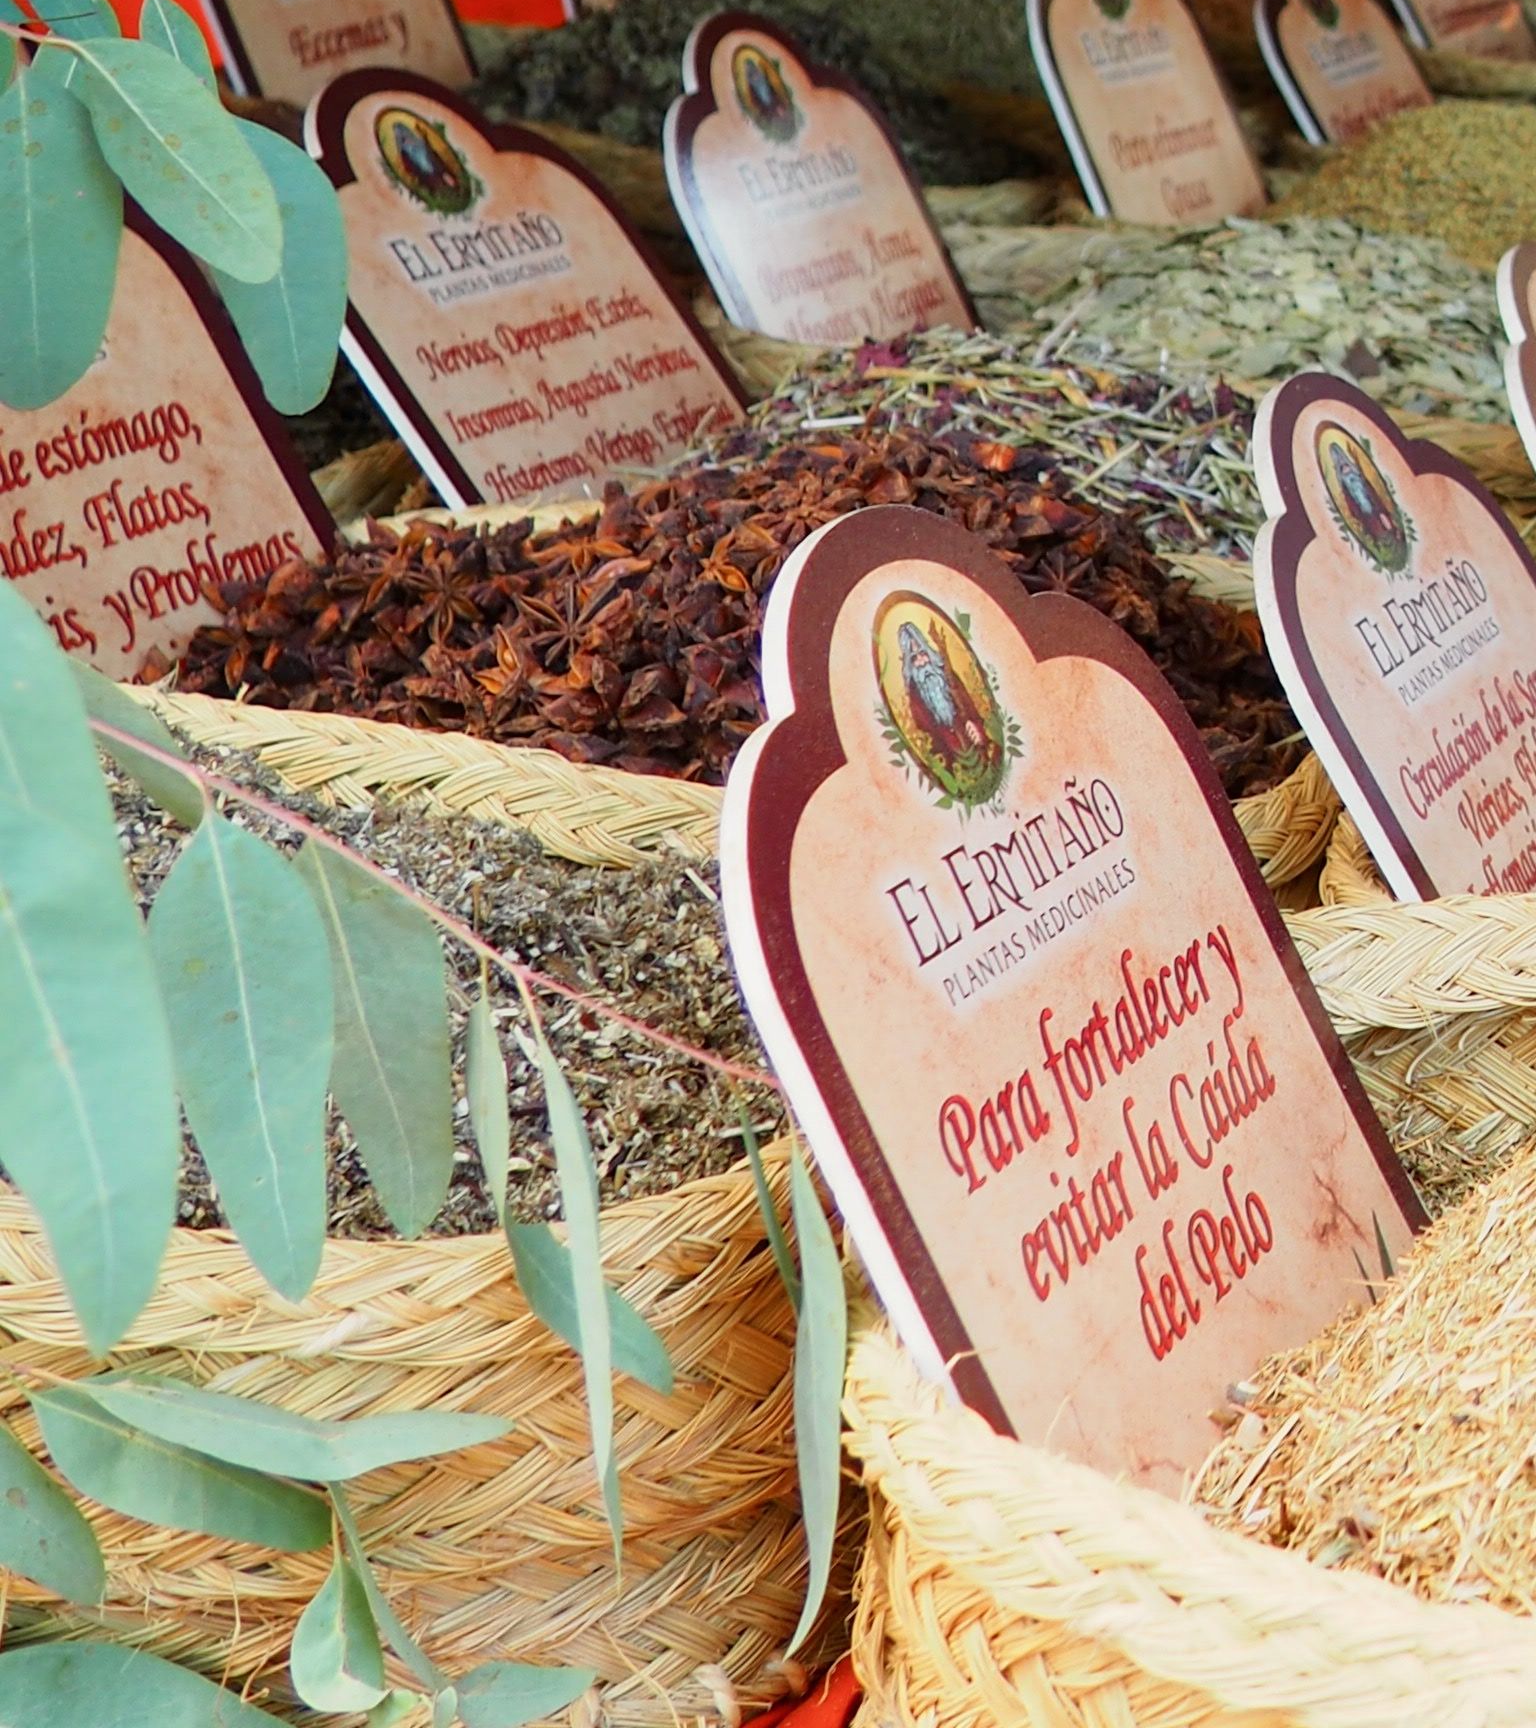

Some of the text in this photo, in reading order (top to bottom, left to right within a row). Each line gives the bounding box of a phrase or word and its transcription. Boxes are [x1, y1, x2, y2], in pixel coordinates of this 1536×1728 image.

[390, 237, 436, 283] EL
[415, 330, 505, 383] Nervios,
[35, 403, 202, 480] estómago,
[0, 478, 210, 580] dez, Flatos,
[102, 591, 136, 653] y
[1354, 559, 1489, 678] EL ERMITAÑO
[1398, 616, 1501, 707] PLANTAS MEDICINALES
[1480, 687, 1509, 746] de
[1493, 675, 1526, 731] la
[1399, 712, 1492, 820] Circulación
[885, 774, 1125, 968] EL ERMITAÑO
[942, 857, 1137, 1008] PLANTAS MEDICINALES
[938, 924, 1245, 1196] Para fortalecer y
[1020, 1013, 1277, 1303] evitar la Caída
[1135, 1163, 1274, 1361] del Pelo
